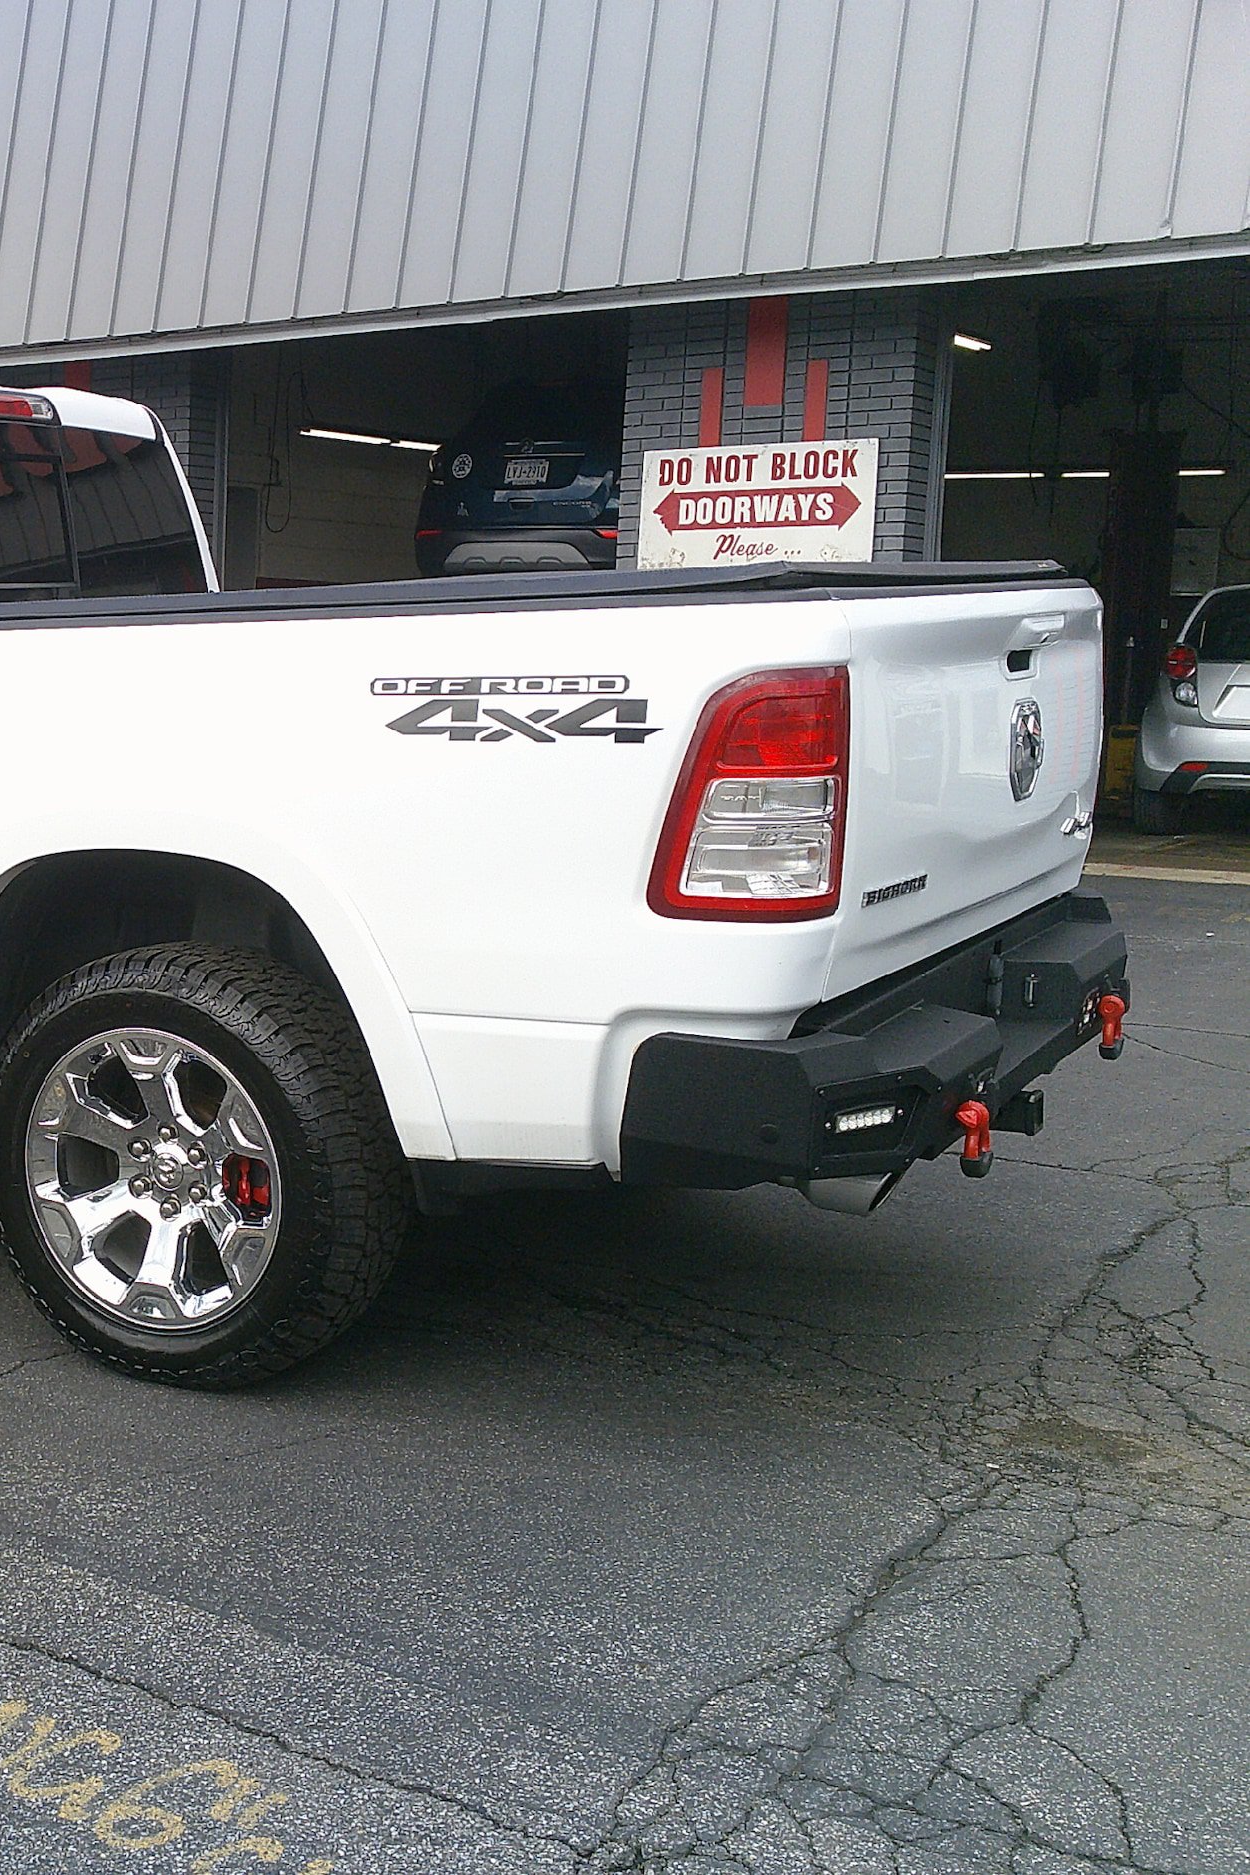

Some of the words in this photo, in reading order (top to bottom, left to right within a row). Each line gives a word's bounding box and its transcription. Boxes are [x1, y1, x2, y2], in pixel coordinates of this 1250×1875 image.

[659, 457, 692, 486] DO
[705, 454, 758, 483] NOT
[771, 449, 859, 481] BLOCK
[678, 492, 834, 526] DOORWAYS
[713, 534, 778, 560] Please
[371, 678, 472, 694] OFF
[480, 677, 626, 694] ROAD
